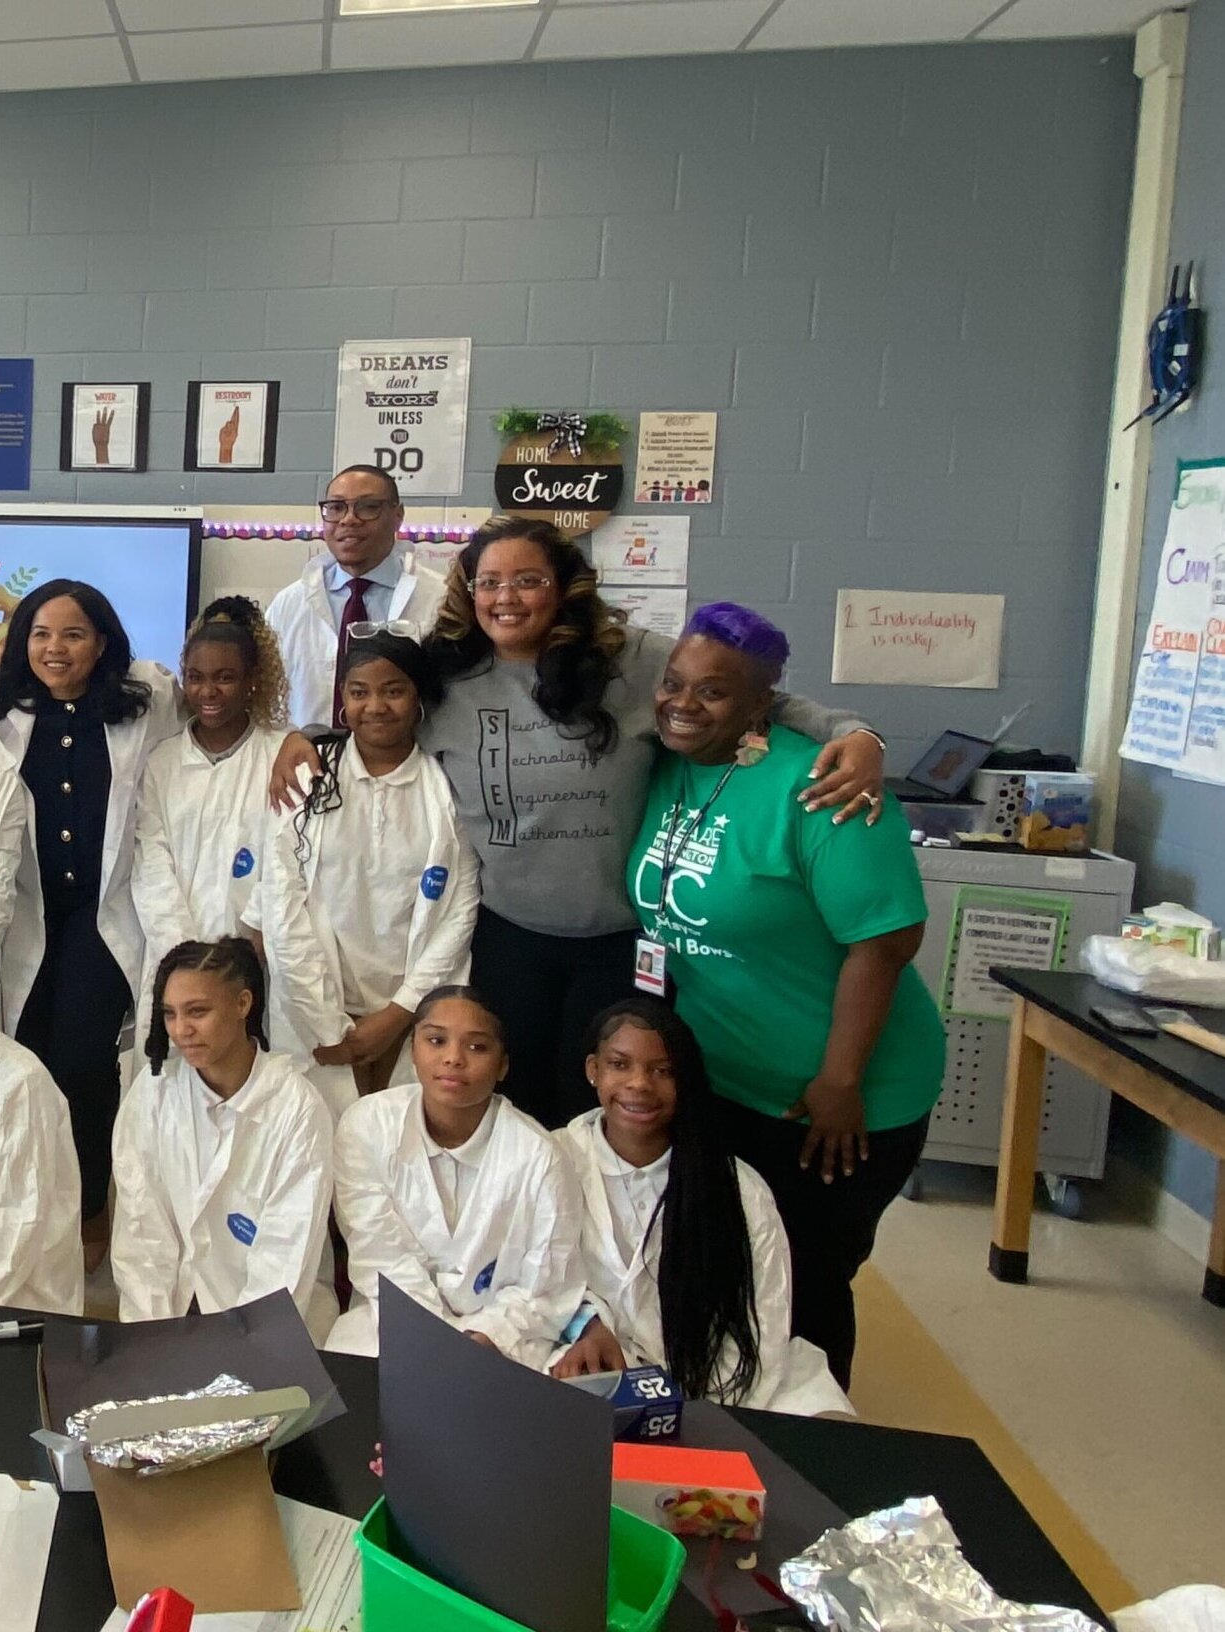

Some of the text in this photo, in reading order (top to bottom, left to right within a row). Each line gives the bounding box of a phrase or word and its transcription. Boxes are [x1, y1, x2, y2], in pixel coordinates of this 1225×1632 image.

[359, 355, 449, 372] DREAMS
[385, 375, 419, 389] don't
[215, 391, 252, 399] RESTROOM
[371, 395, 435, 406] WORK
[378, 411, 423, 425] UNLESS
[374, 447, 423, 472] DO
[516, 447, 551, 463] HOME
[512, 468, 608, 503] Sweet
[554, 511, 590, 529] HOME
[868, 606, 977, 639] Individuality
[637, 1377, 672, 1398] 25
[648, 1414, 677, 1437] 25
